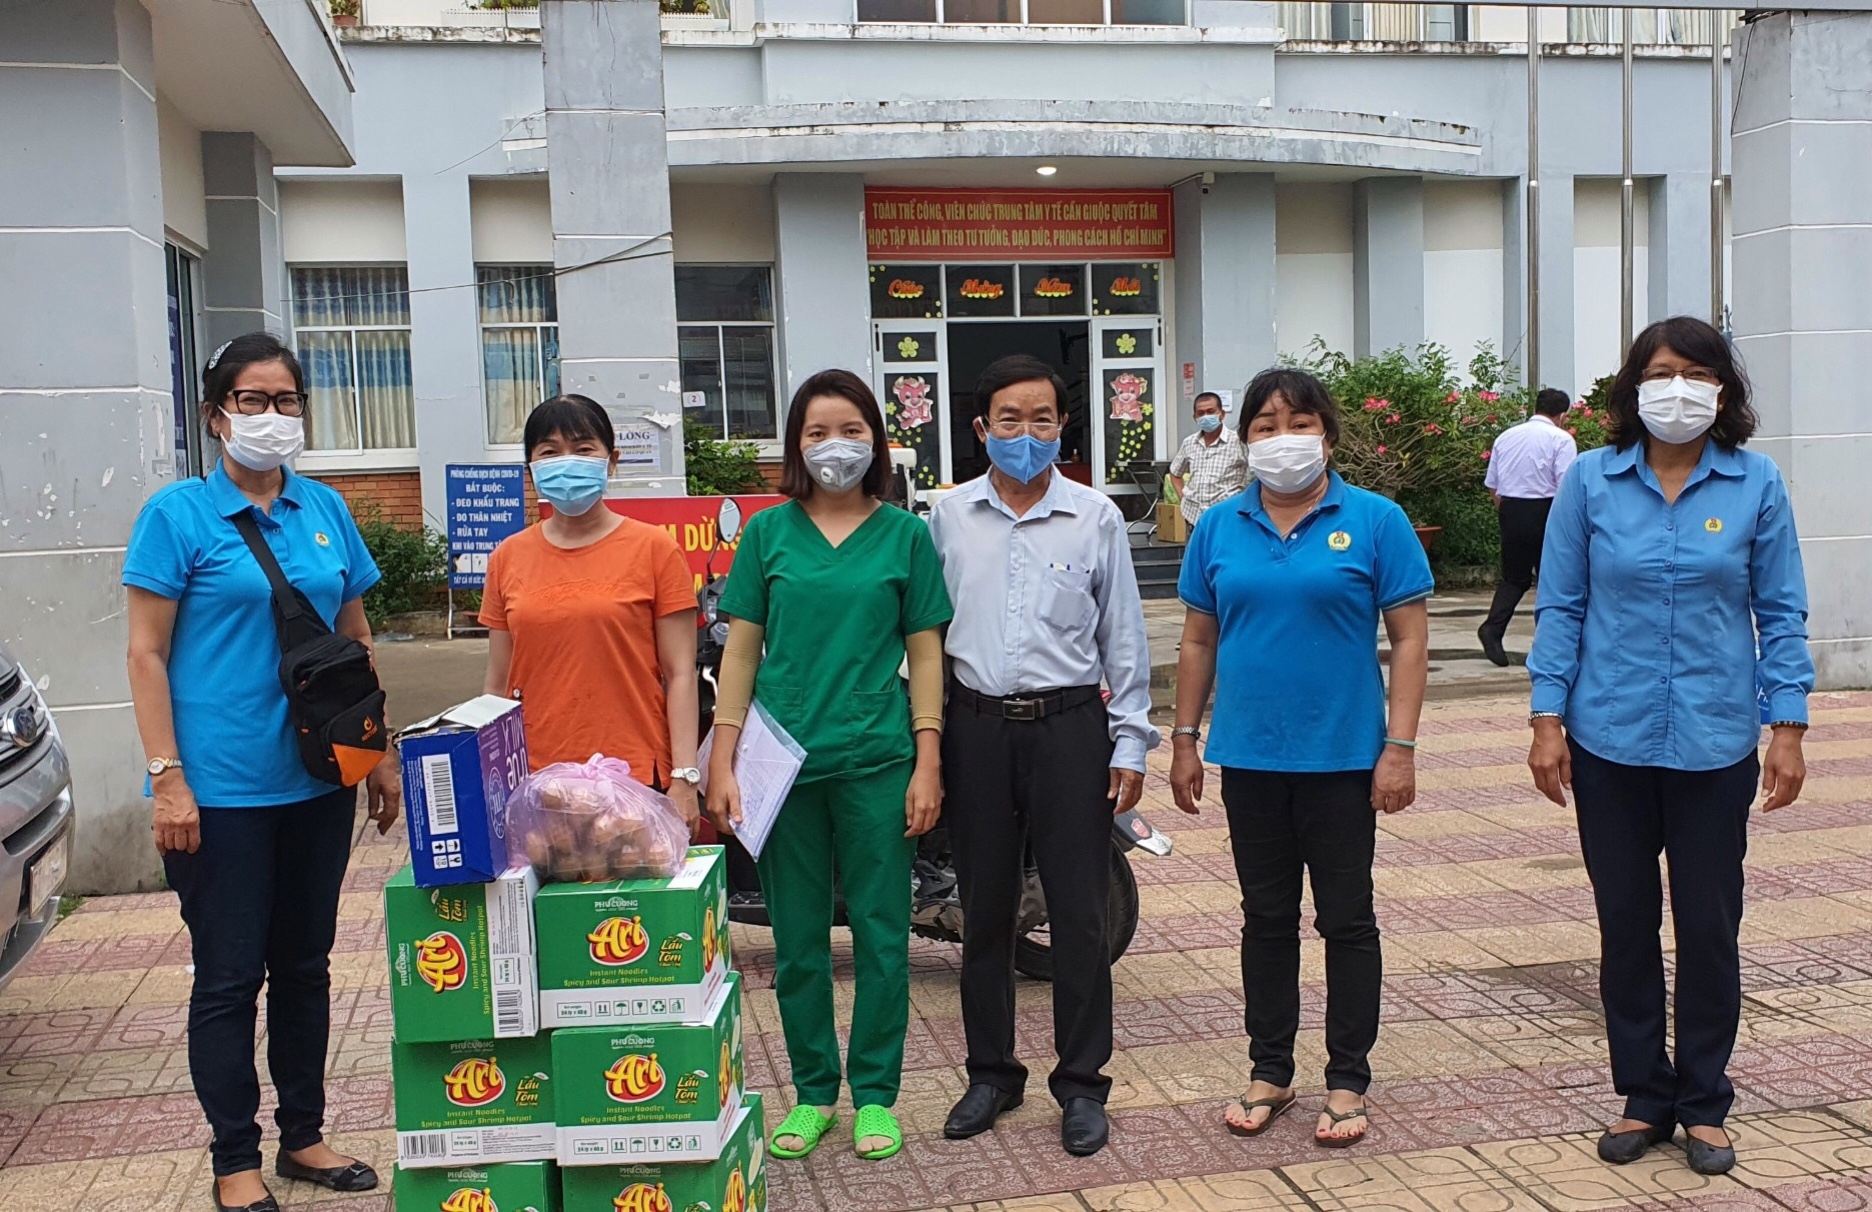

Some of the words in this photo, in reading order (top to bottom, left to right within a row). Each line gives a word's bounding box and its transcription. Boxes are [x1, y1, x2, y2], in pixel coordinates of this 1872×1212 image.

[872, 200, 897, 219] TOÀN
[898, 198, 915, 220] THỂ
[917, 200, 944, 221] CÔNG,
[945, 200, 965, 220] VIÊN
[967, 200, 992, 220] CHỨC
[993, 204, 1022, 220] TRUNG
[1024, 201, 1043, 220] TÂM
[1044, 204, 1050, 220] Y
[1051, 200, 1062, 220] TẾ
[1083, 201, 1110, 224] GIUỘC
[1112, 200, 1137, 222] QUYẾT
[1139, 201, 1158, 220] TÂM
[889, 226, 906, 249] TẬP
[907, 226, 920, 246] VÀ
[921, 226, 940, 246] LÀM
[941, 229, 964, 246] THEO
[965, 229, 977, 246] TƯ
[1011, 229, 1030, 250] ĐẠO
[1053, 229, 1083, 246] PHONG
[1084, 226, 1108, 246] CÁCH
[1123, 226, 1139, 246] CHÍ
[691, 395, 697, 403] 2
[620, 430, 650, 441] LÒNG
[456, 498, 471, 507] ĐEO
[495, 498, 519, 507] TRANG
[456, 513, 467, 522] ĐO
[468, 511, 490, 522] THÂN
[491, 510, 512, 523] NHIỆT
[473, 528, 488, 537] TAY
[452, 541, 462, 550] KHI
[463, 540, 474, 550] VÀO
[475, 542, 493, 550] TRUNG
[588, 916, 645, 959] Ari
[479, 932, 487, 959] Shrimp
[414, 935, 460, 993] Ari
[589, 969, 616, 977] Instant
[564, 979, 584, 987] Spicy
[620, 977, 648, 985] Shrimp
[649, 975, 675, 983] Hotpot
[444, 1057, 502, 1099] Ari
[604, 1053, 662, 1095] Ari
[447, 1109, 473, 1117] Instant
[581, 1116, 600, 1124] Spicy
